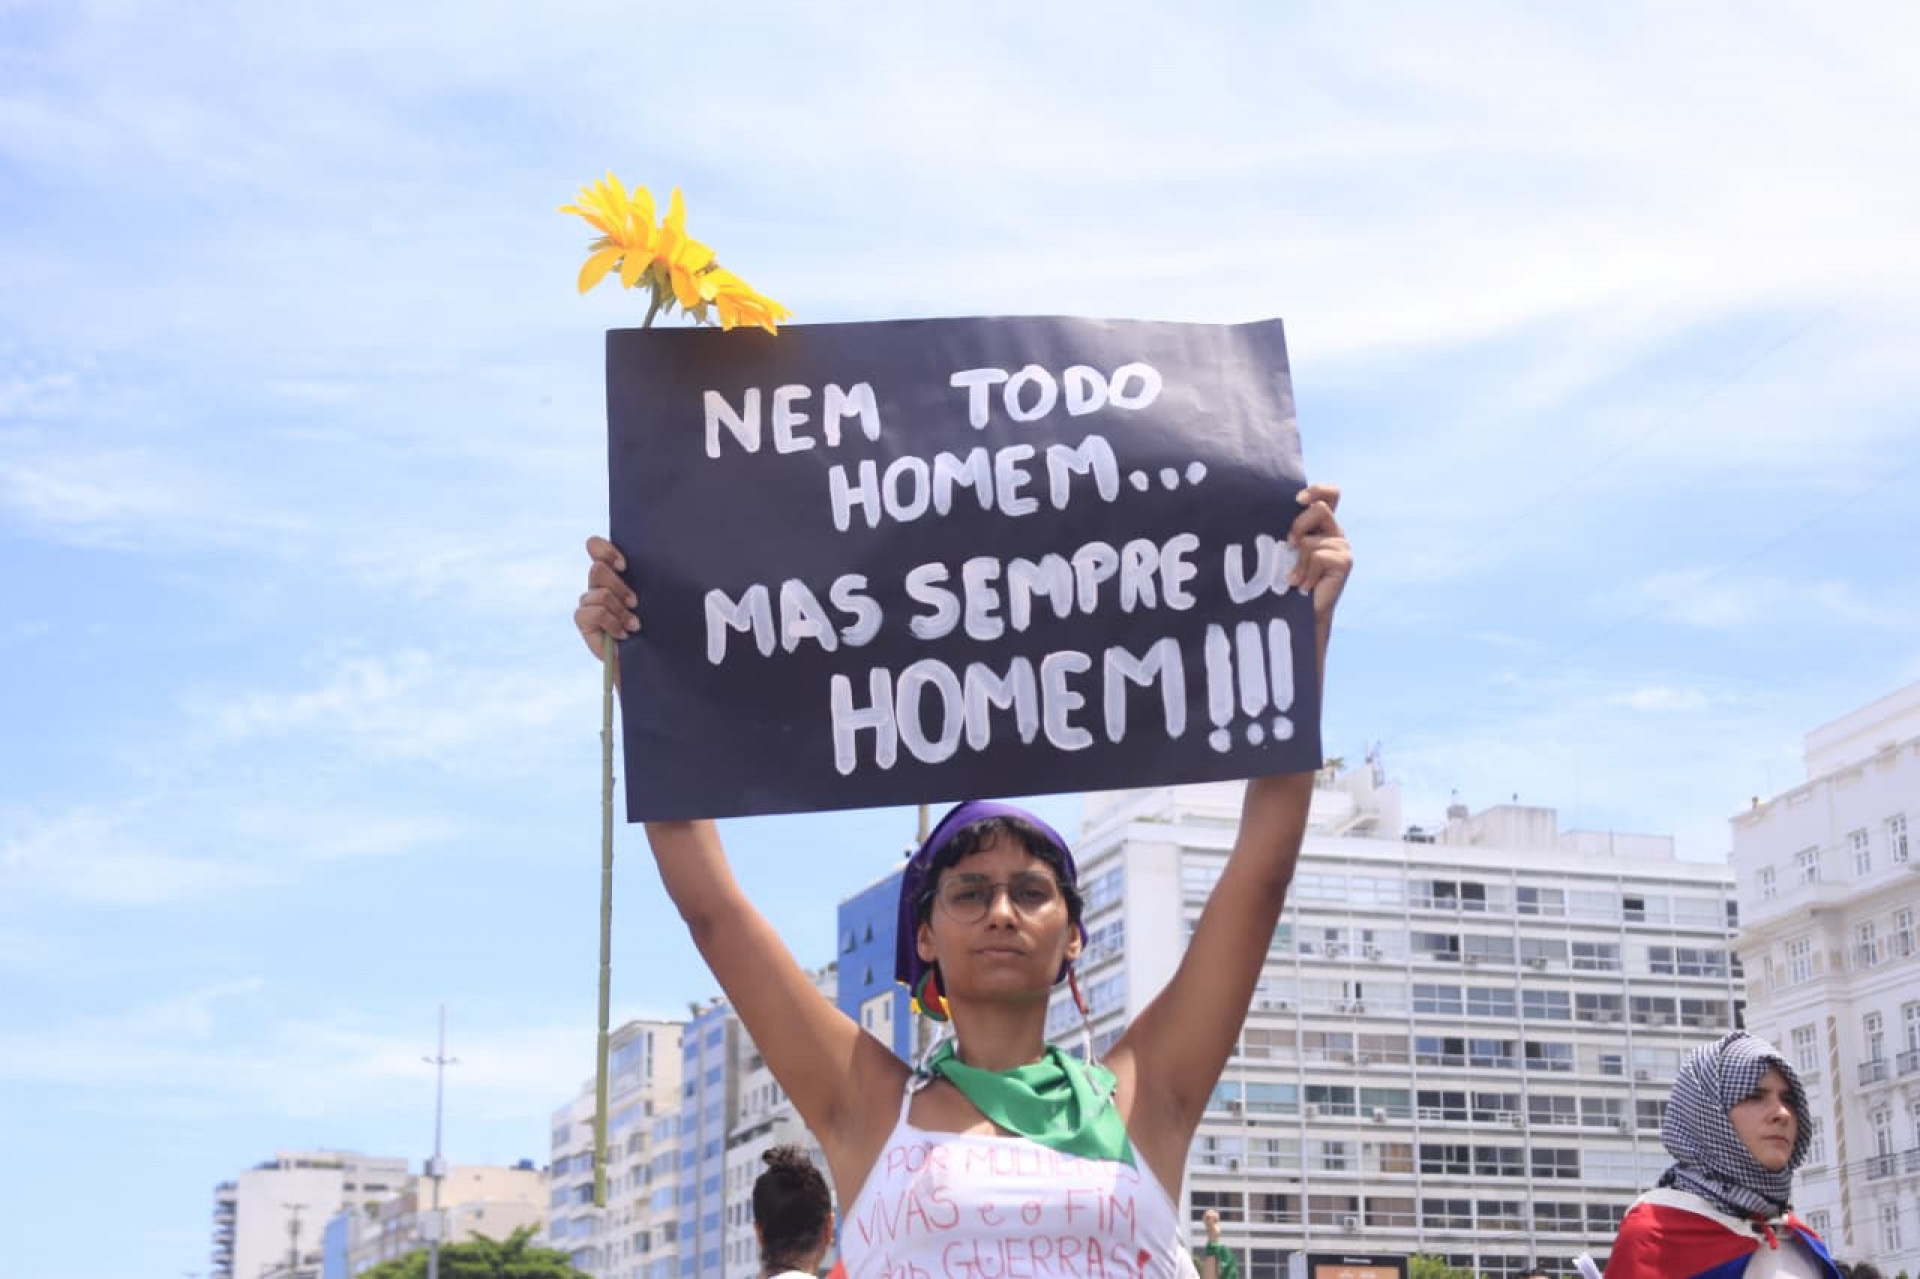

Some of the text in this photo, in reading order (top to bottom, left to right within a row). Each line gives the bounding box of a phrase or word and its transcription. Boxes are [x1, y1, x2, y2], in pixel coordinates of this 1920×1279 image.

[703, 362, 1163, 459] NEM TODO
[704, 573, 883, 665] MAS
[905, 533, 1201, 641] SEMPRE
[886, 1143, 949, 1177] POR
